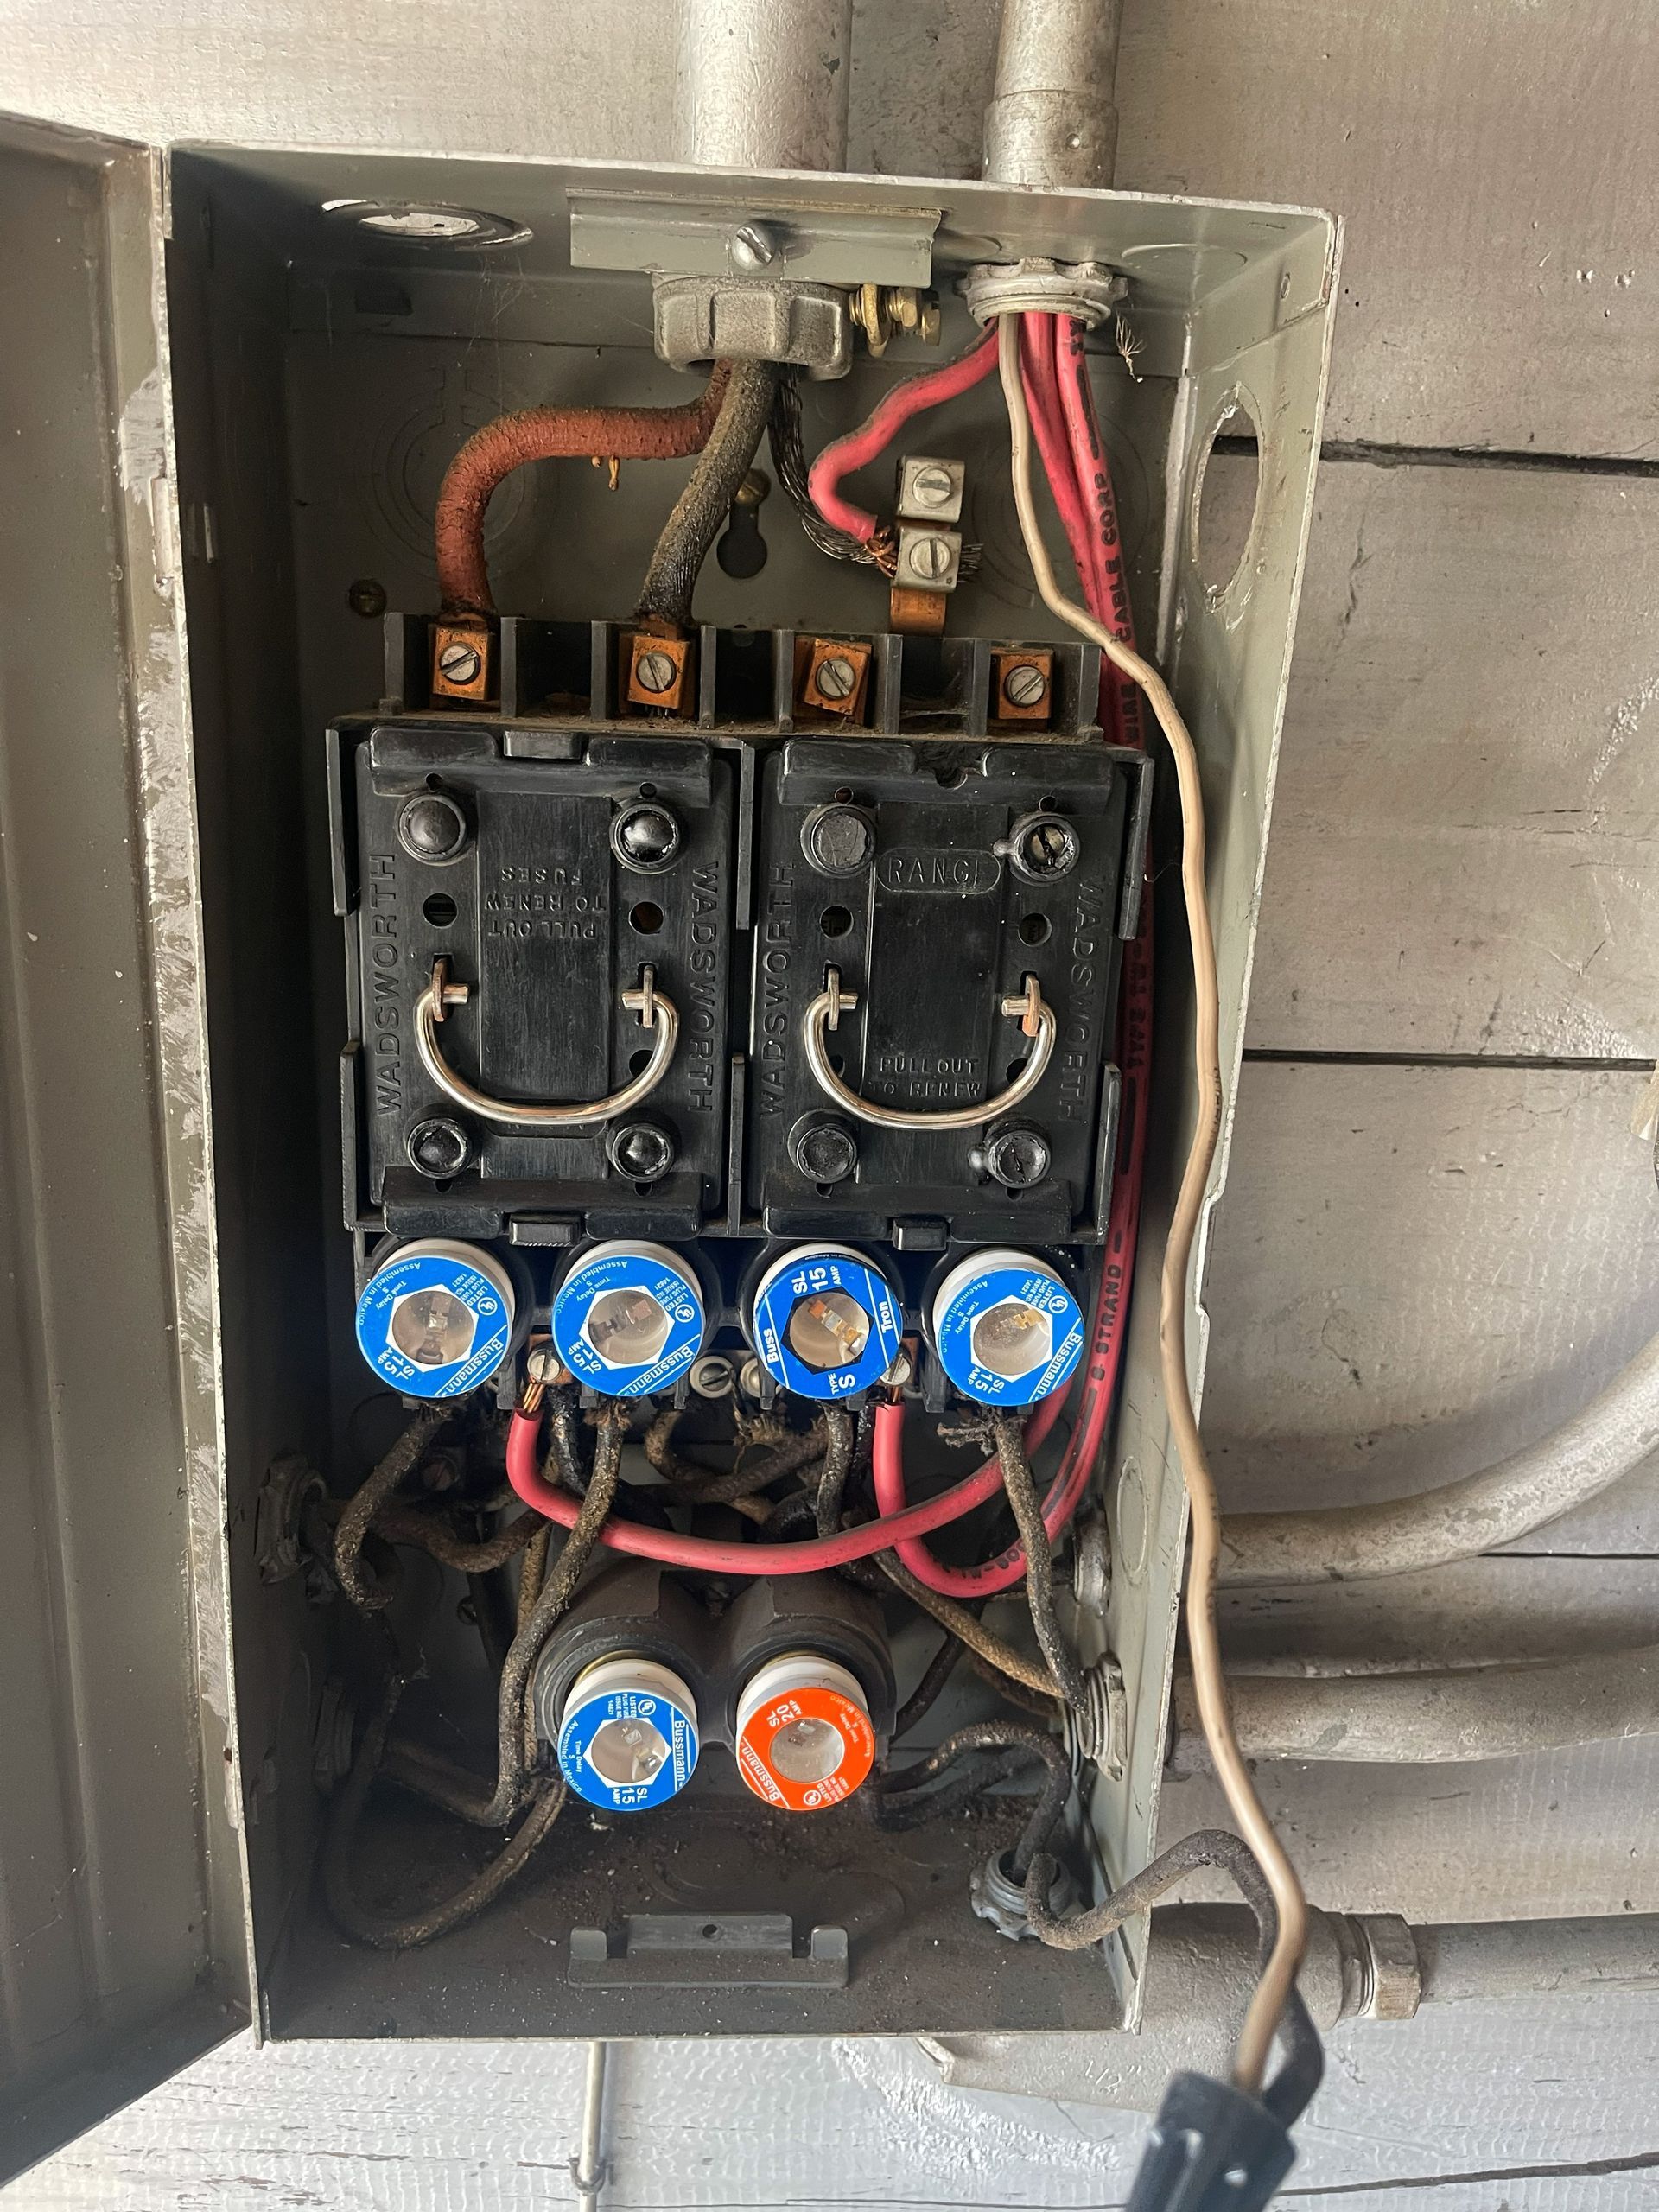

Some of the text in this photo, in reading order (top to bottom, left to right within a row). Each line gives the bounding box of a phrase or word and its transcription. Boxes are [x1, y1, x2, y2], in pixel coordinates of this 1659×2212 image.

[1094, 472, 1116, 546] CORP
[1105, 556, 1131, 643] CABLE
[500, 867, 583, 886] FUSES
[484, 893, 606, 912] TO RENEW
[487, 919, 597, 939] PULL OUT
[372, 853, 402, 1116] WADSWORTH
[689, 861, 720, 1114] WADSWORTH
[760, 863, 797, 1119] WADSWORTH
[880, 1056, 980, 1075] PULL OUT
[581, 1261, 628, 1280] Assembled
[809, 1267, 829, 1291] 15
[830, 1266, 842, 1285] AMP
[461, 1274, 477, 1289] ISSUE
[470, 1277, 484, 1291] PLUG
[576, 1276, 611, 1302] Time Delay
[663, 1280, 679, 1293] ISSUE
[791, 1271, 808, 1294] SL
[1029, 1277, 1042, 1294] ISSUE
[1039, 1278, 1050, 1293] PLUG
[359, 1262, 421, 1325] Assembled in Mexico
[376, 1281, 407, 1310] Time Delay
[466, 1284, 487, 1306] LISTED
[556, 1288, 575, 1314] Mexico
[659, 1283, 686, 1306] PLUG FUSE
[664, 1292, 688, 1312] LISTED
[951, 1281, 988, 1313] Assembled
[1037, 1285, 1054, 1309] LISTED
[879, 1302, 893, 1333] Tron
[955, 1300, 980, 1334] Time Delay
[1095, 1262, 1122, 1355] STRAND
[378, 1347, 393, 1364] AMP
[568, 1338, 584, 1355] AMP
[763, 1328, 779, 1363] Buss
[384, 1355, 404, 1375] 15
[446, 1338, 504, 1396] Bussmann
[573, 1349, 594, 1366] 15
[582, 1360, 602, 1375] SL
[1037, 1332, 1082, 1395] Bussmann
[397, 1365, 416, 1380] SL
[626, 1346, 695, 1394] Bussmann
[967, 1366, 981, 1385] AMP
[975, 1370, 993, 1391] 15
[828, 1373, 839, 1395] TYPE
[838, 1374, 855, 1389] S
[988, 1380, 1004, 1395] SL
[778, 1705, 795, 1722] 20
[789, 1700, 803, 1715] AMP
[766, 1711, 780, 1727] SL
[562, 1720, 578, 1760] Assembled
[674, 1720, 686, 1783] Bussmann
[564, 1770, 582, 1792] Mexico
[741, 1745, 780, 1802] Bussmann
[622, 1788, 635, 1803] 15
[636, 1788, 647, 1803] SL
[816, 1782, 832, 1802] LISTED
